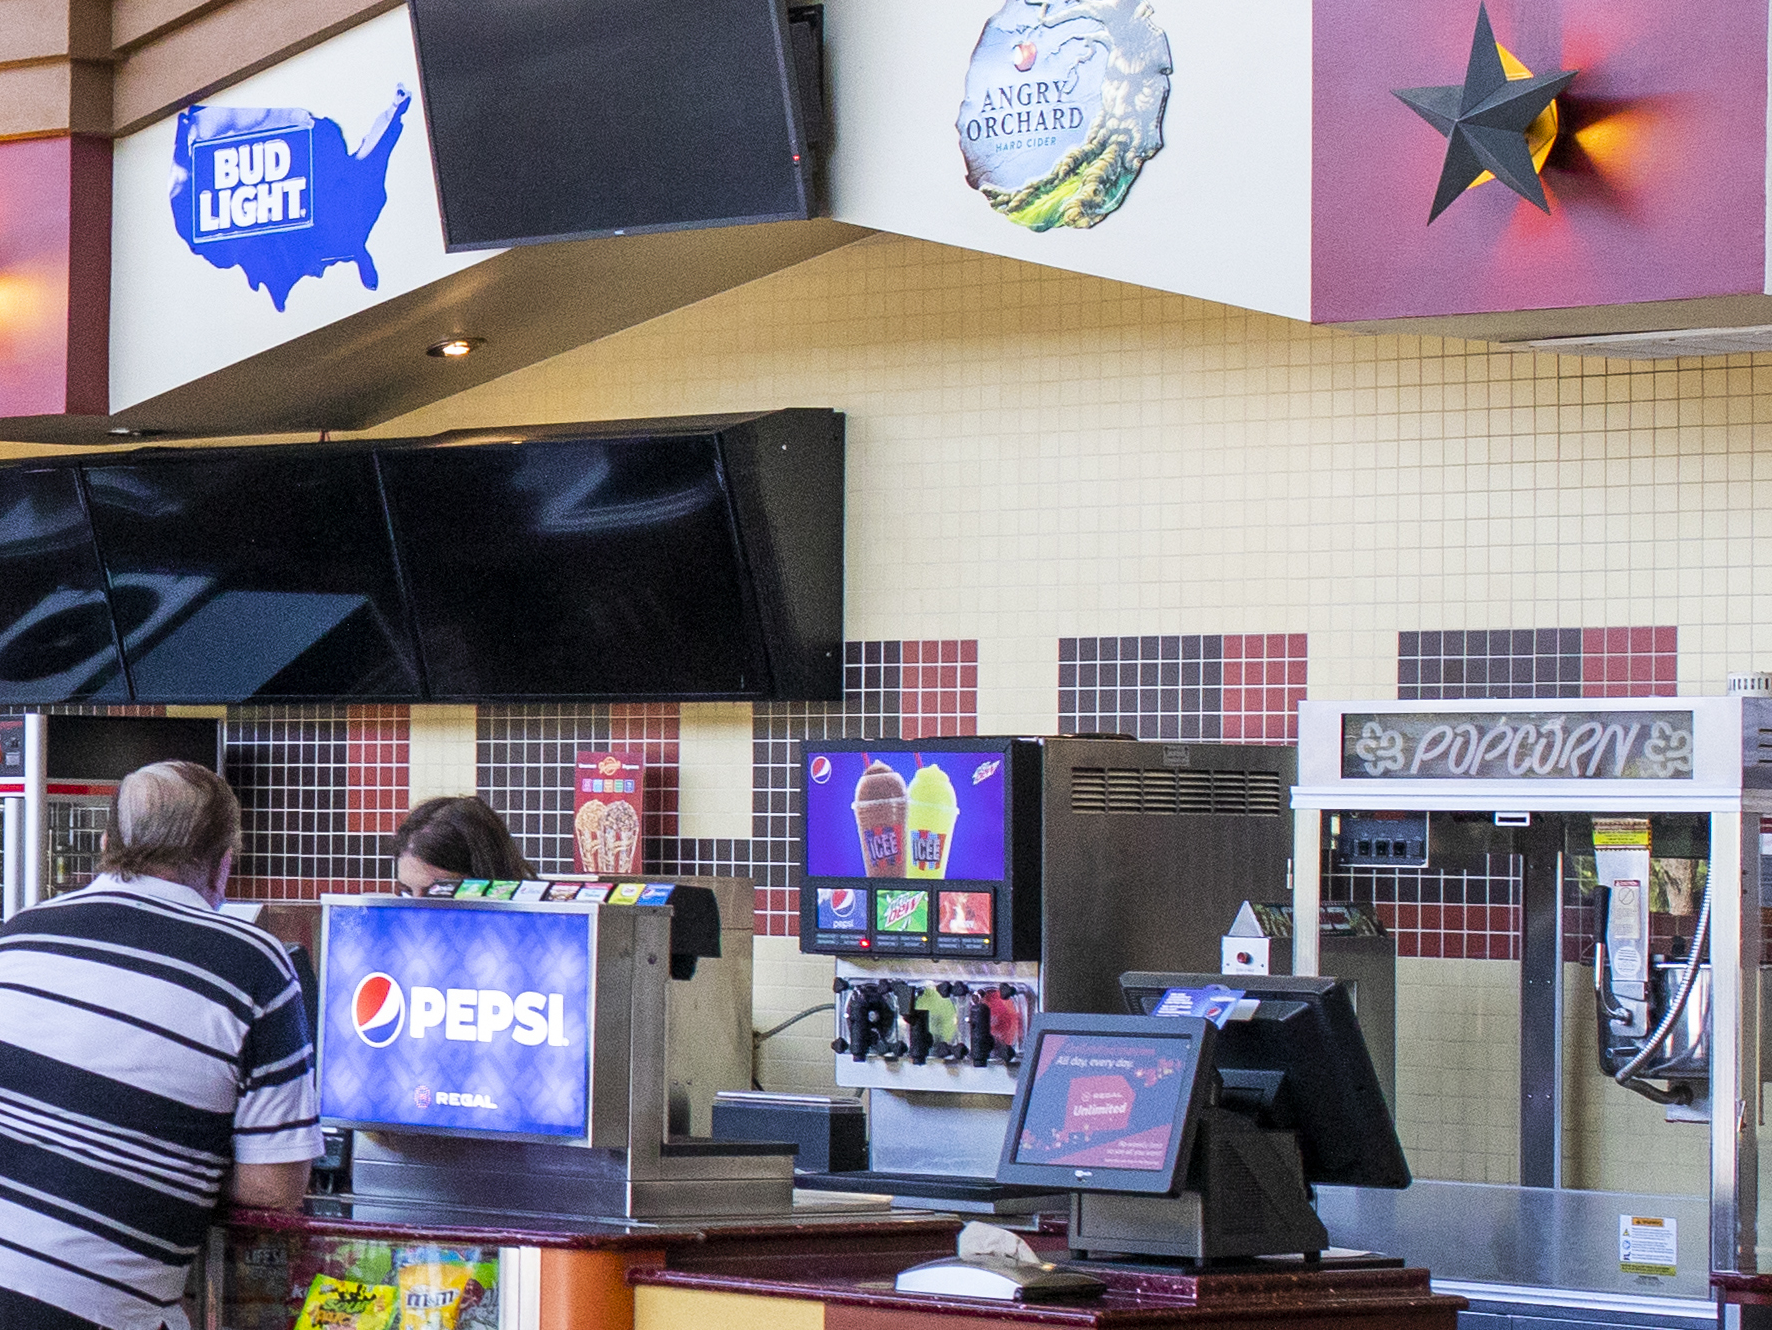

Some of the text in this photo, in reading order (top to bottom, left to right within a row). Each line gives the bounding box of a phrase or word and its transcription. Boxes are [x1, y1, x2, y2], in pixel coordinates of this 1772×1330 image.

[981, 80, 1068, 113] ANGRY
[967, 107, 1083, 141] ORCHARD
[996, 137, 1057, 151] HARD CIDER
[214, 138, 291, 190] BUD
[199, 176, 307, 232] LIGHT
[1410, 722, 1640, 776] POPCORN
[869, 832, 899, 861] ICEE
[913, 837, 941, 862] ICEE
[409, 987, 569, 1047] PEPSI
[436, 1092, 497, 1109] REGAL
[1073, 1102, 1127, 1117] Unlimited
